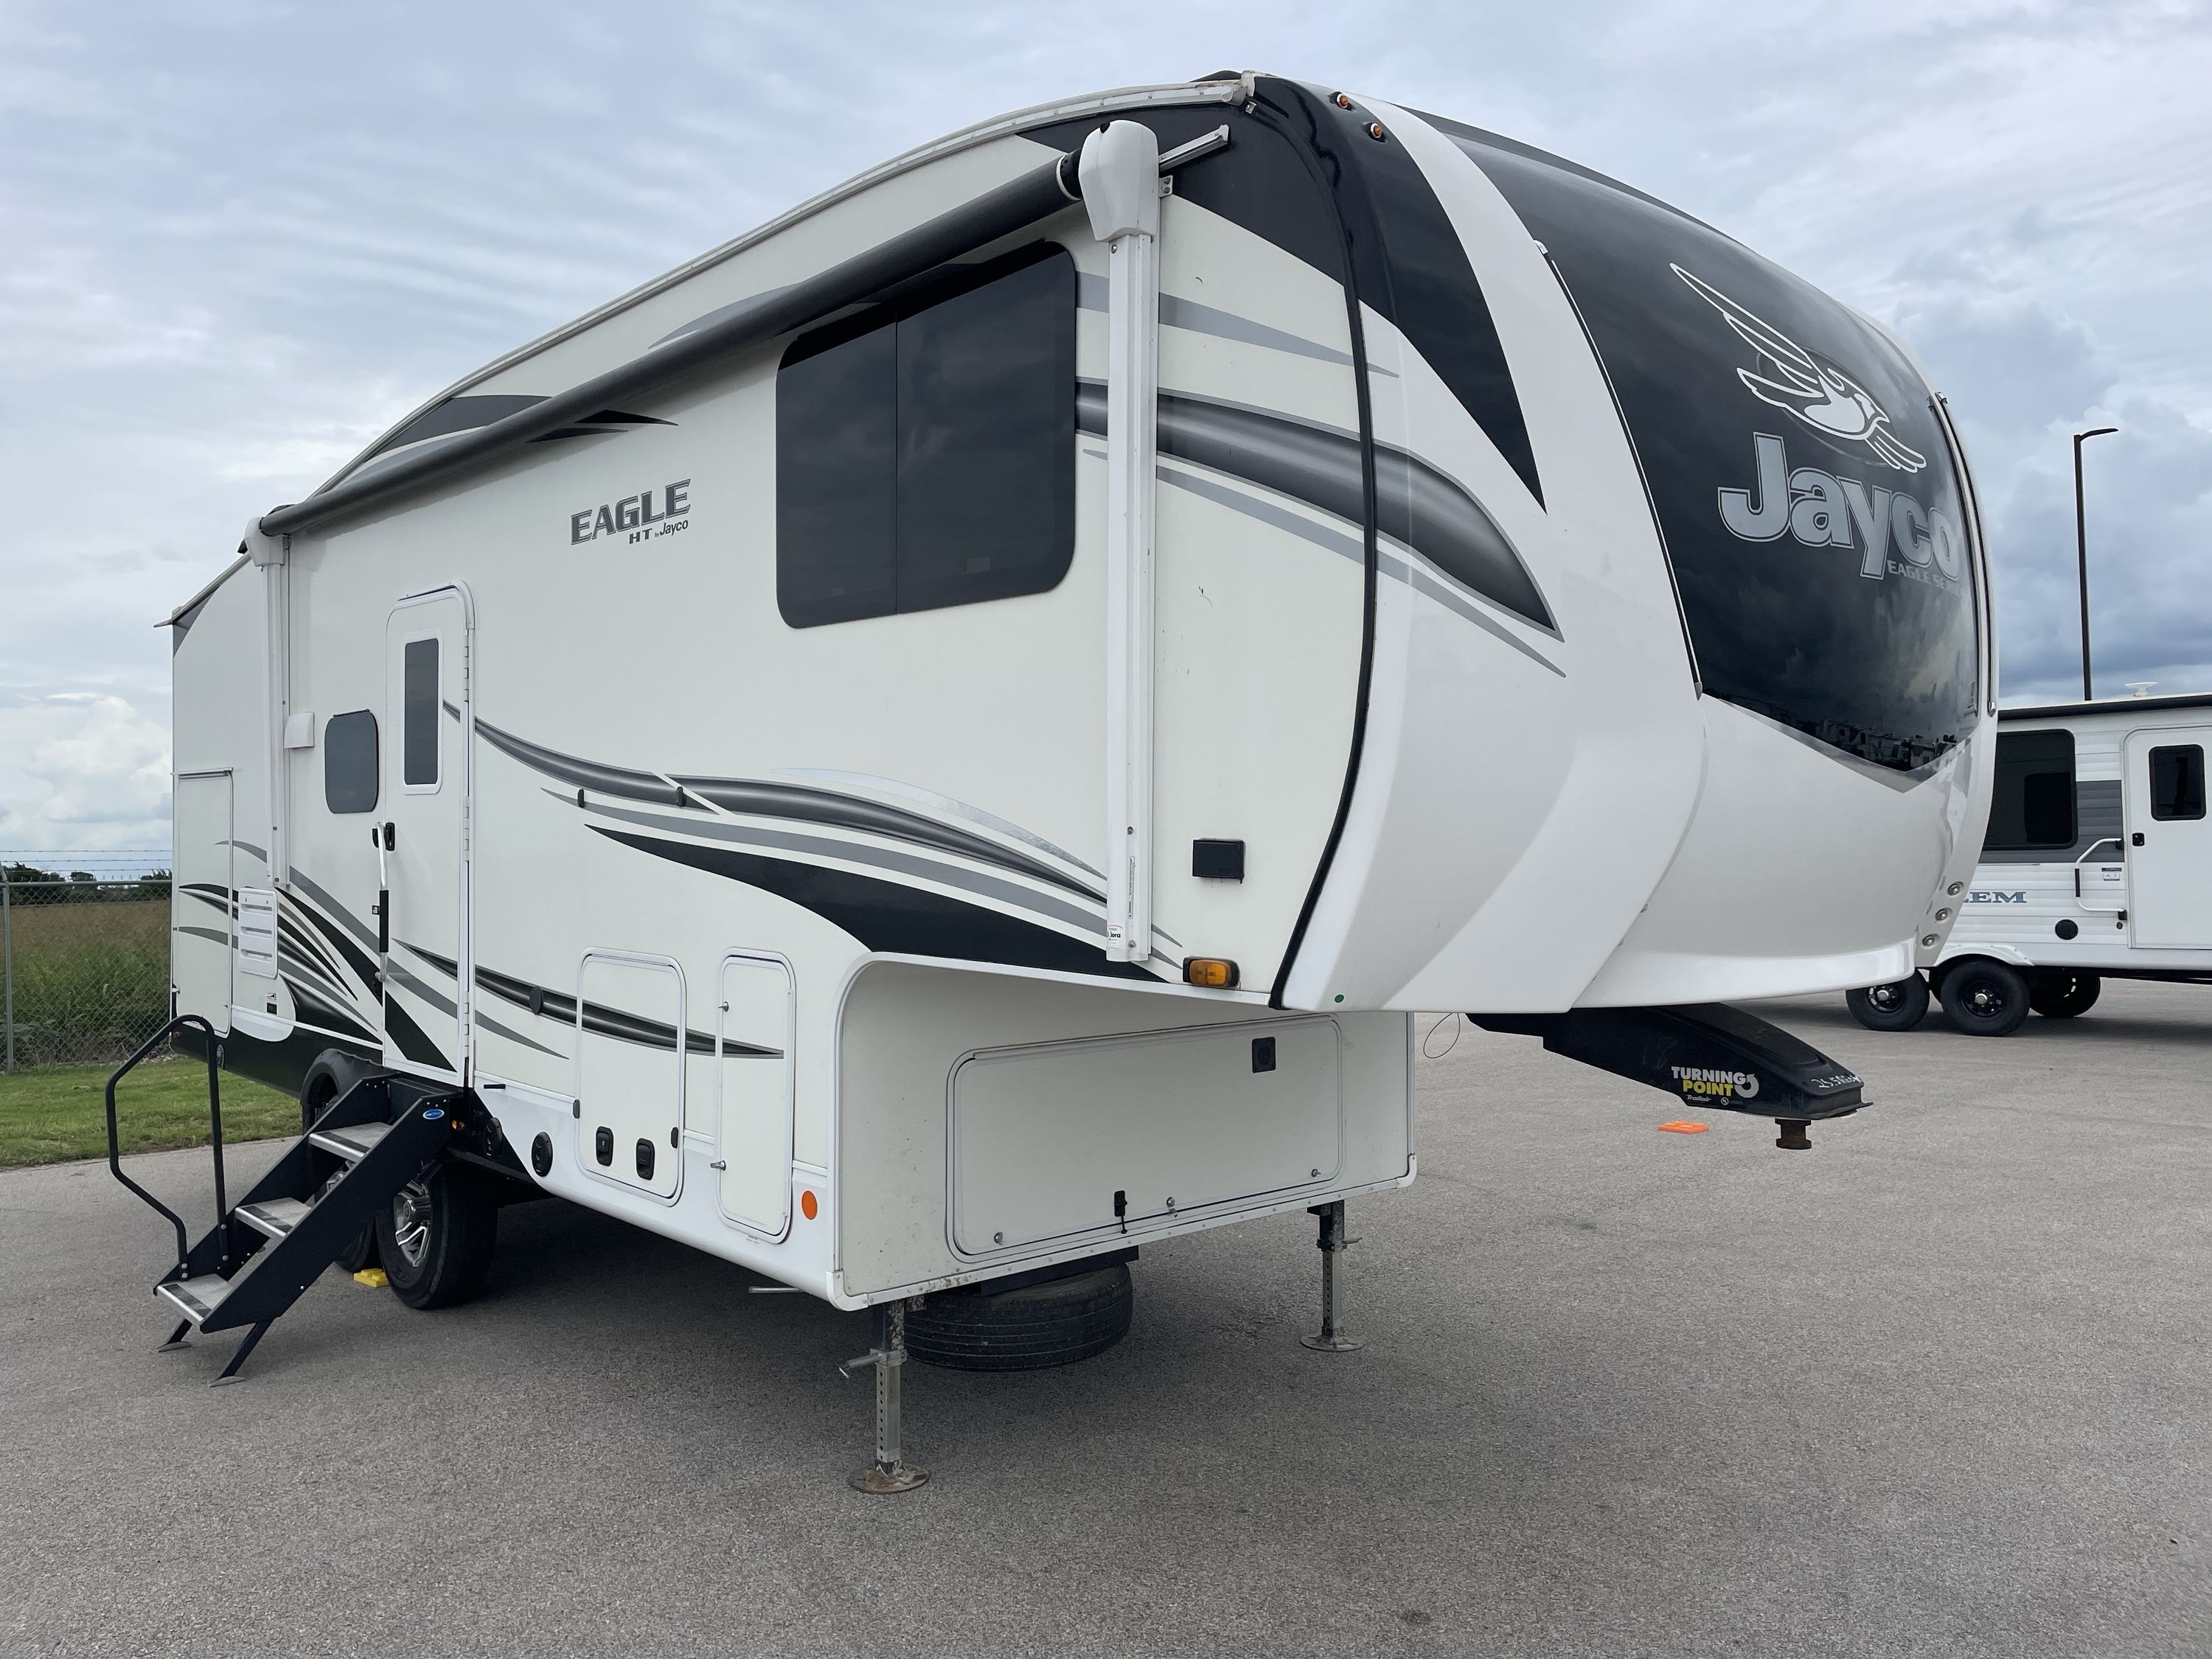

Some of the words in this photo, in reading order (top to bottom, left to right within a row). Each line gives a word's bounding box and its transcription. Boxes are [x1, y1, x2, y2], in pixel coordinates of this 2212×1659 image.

[571, 479, 691, 546] EAGLE
[1718, 431, 1959, 581] Jayco
[629, 528, 653, 544] HT
[660, 520, 689, 536] Jayco
[1887, 560, 1932, 585] EAGLE
[1671, 1066, 1747, 1085] TURNING
[1683, 1079, 1733, 1096] POINT
